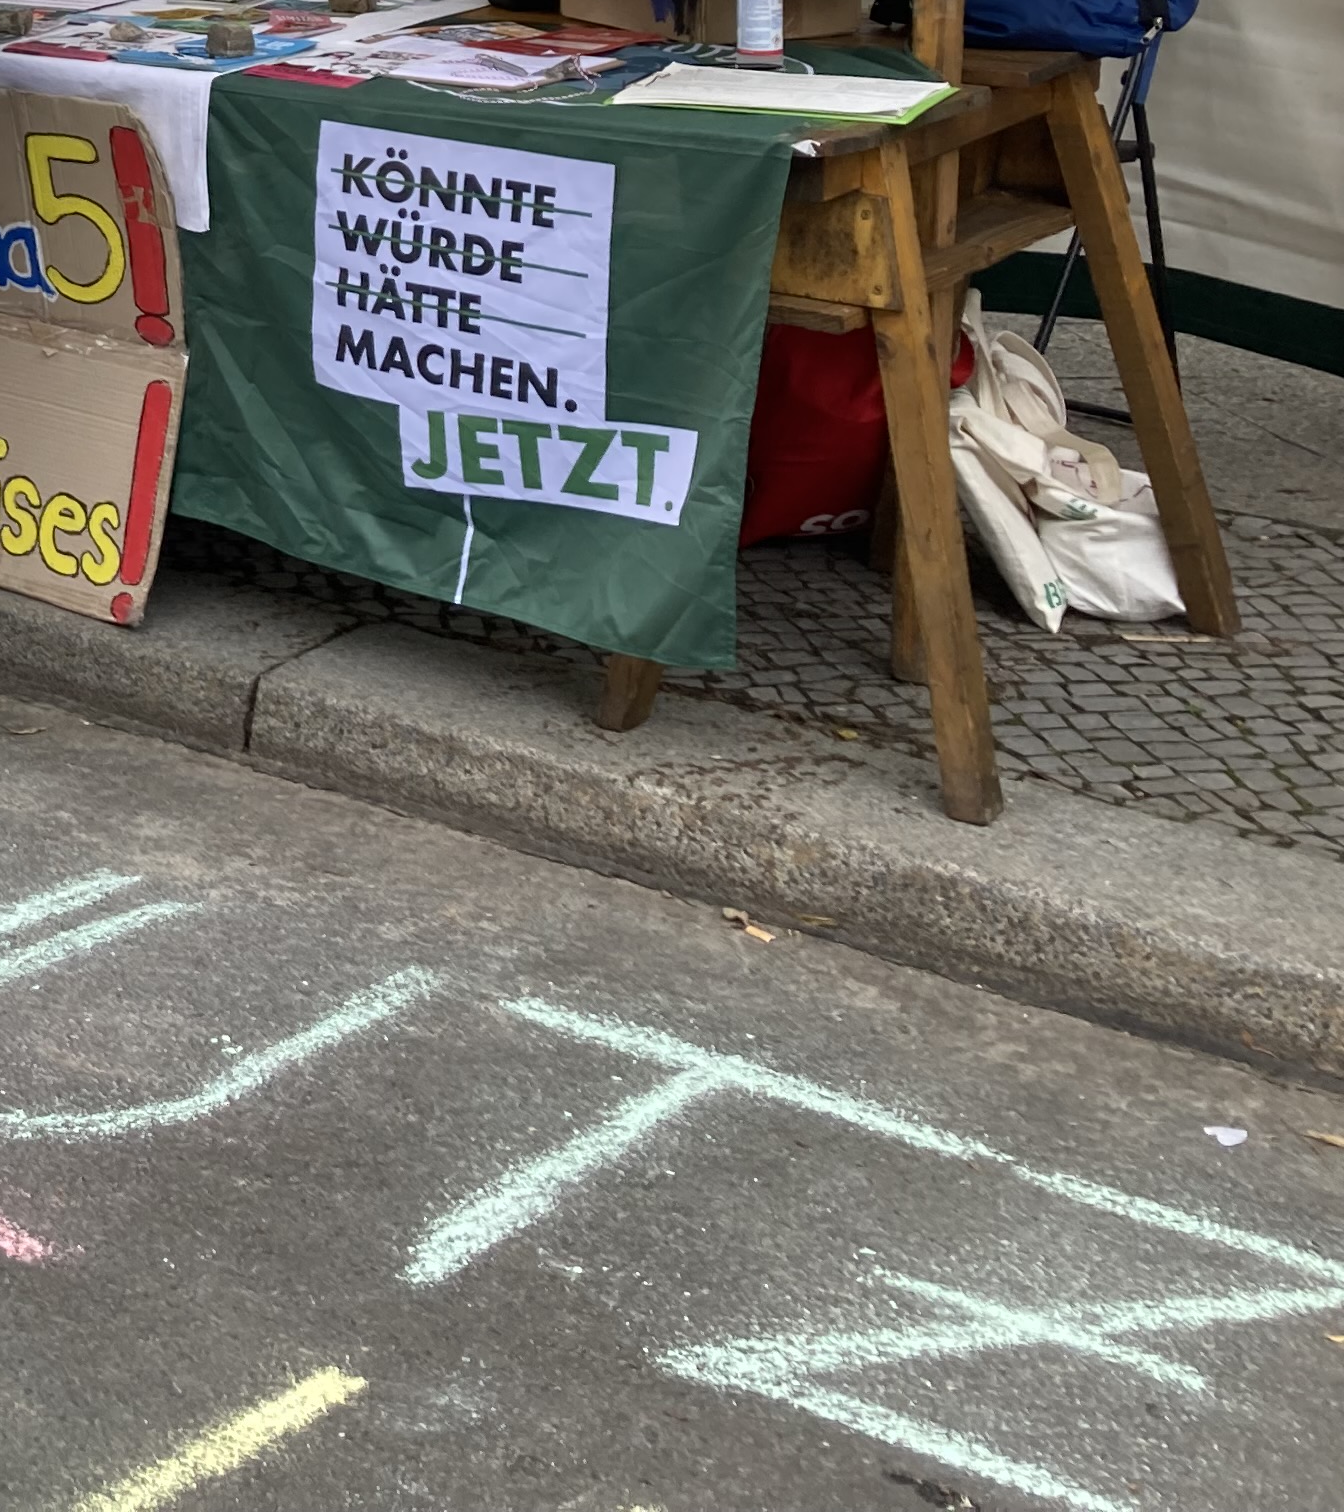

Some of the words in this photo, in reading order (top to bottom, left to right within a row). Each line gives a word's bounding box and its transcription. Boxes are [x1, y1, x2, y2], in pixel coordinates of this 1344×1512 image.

[341, 146, 557, 229] KÖNNTE
[336, 207, 525, 284] WÜRDE
[336, 263, 483, 336] HÄTTE
[335, 324, 578, 413] MACHEN.
[411, 409, 674, 513] JETZT.
